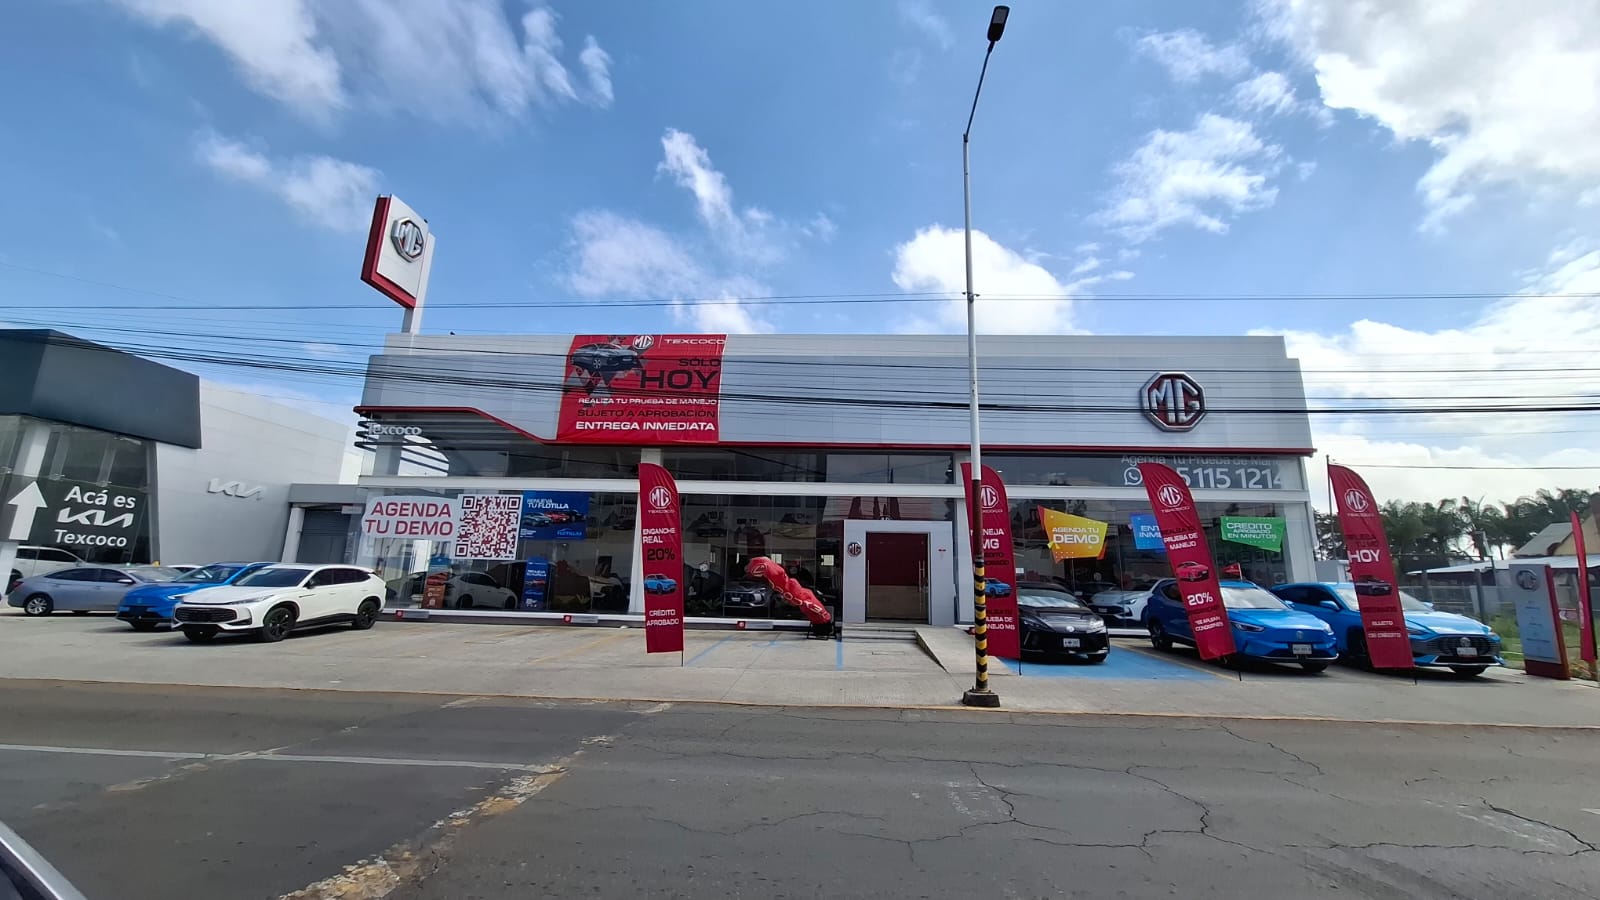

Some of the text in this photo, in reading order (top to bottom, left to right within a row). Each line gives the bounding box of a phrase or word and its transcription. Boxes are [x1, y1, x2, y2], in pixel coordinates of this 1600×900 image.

[395, 219, 424, 259] MG
[633, 336, 653, 349] MG
[664, 337, 726, 345] TEXCOCO
[639, 370, 719, 389] HOY
[578, 397, 614, 405] REALIZA
[1146, 376, 1202, 426] MG
[577, 408, 716, 418] SUJETO A APROBACIÓN
[366, 421, 422, 436] Texcoco
[575, 421, 716, 431] ENTREGA INMEDIATA
[1121, 454, 1166, 467] Agenda
[1173, 455, 1186, 465] Tu
[1188, 455, 1229, 466] Prueba
[63, 485, 137, 509] Acá es
[650, 486, 671, 508] MG
[1159, 486, 1183, 507] MG
[1346, 489, 1368, 511] MG
[371, 501, 451, 517] AGENDA
[57, 507, 134, 528] KIA
[365, 518, 454, 536] TU DEMO
[642, 527, 676, 535] ENGANCHE
[54, 529, 127, 547] Texcoco
[642, 536, 664, 544] REAL
[1053, 534, 1100, 545] DEMO
[848, 542, 862, 556] MG
[1169, 541, 1197, 550] MANEJO
[647, 548, 676, 561] 20%
[1347, 549, 1381, 563] HOY
[1187, 592, 1214, 606] 20%
[646, 617, 680, 626] APROBADO
